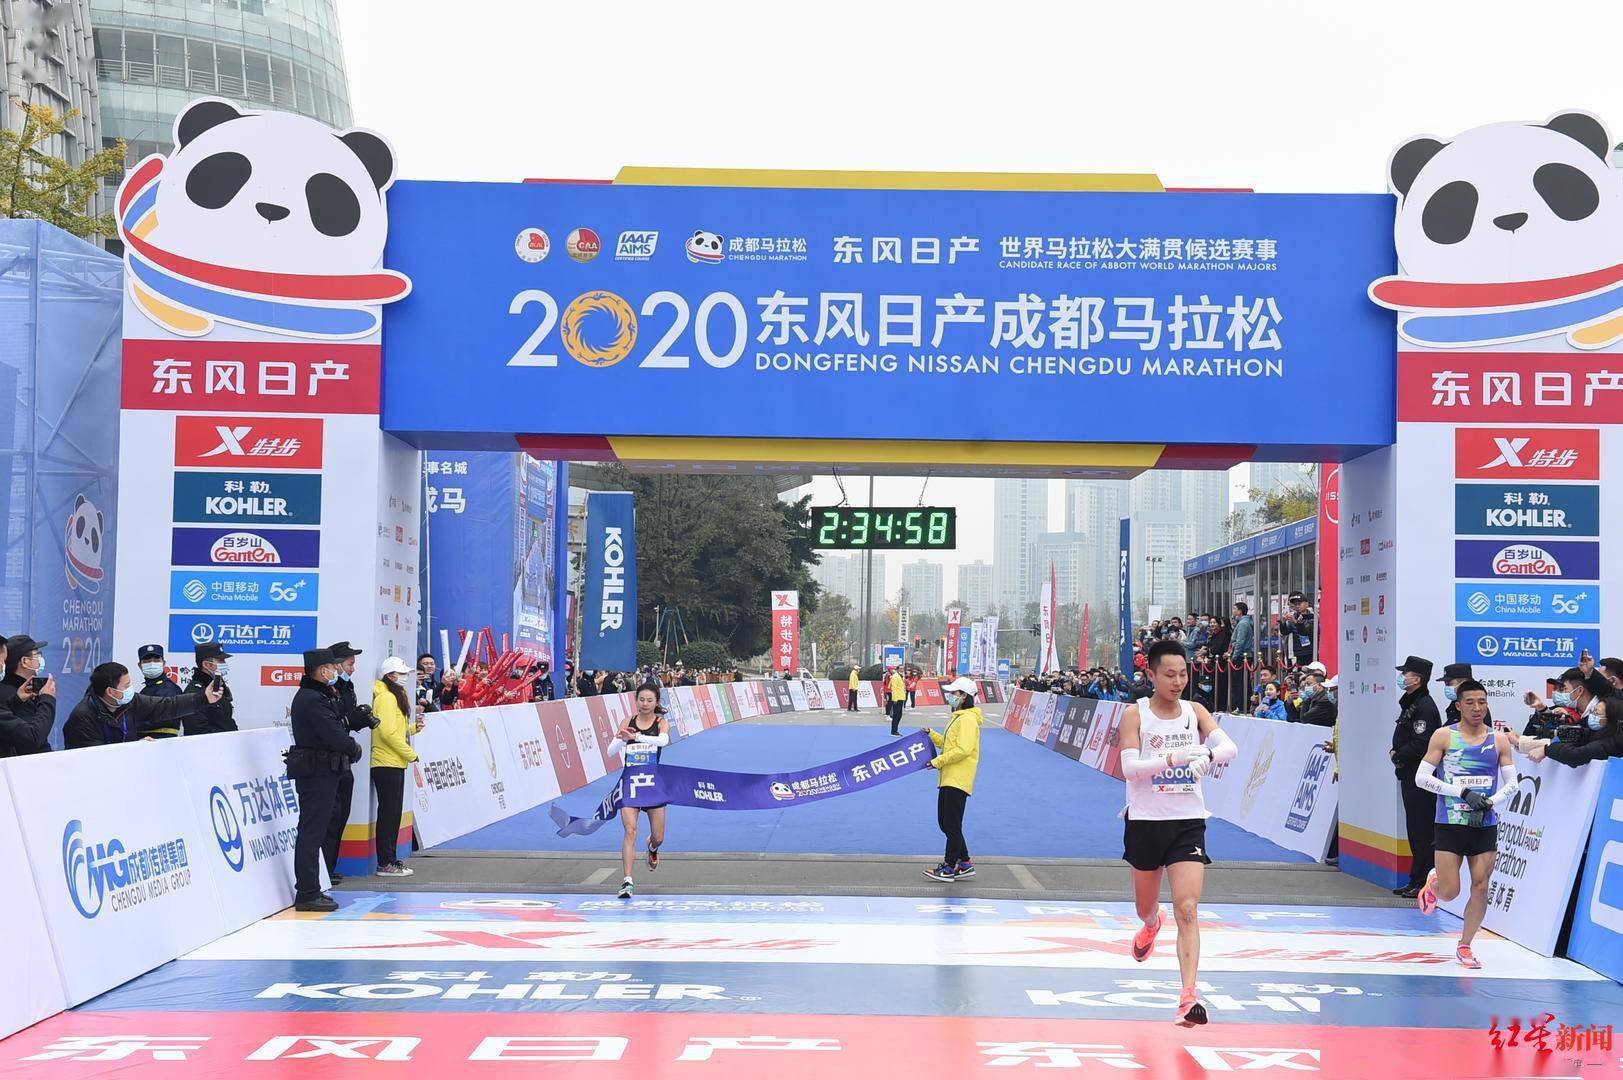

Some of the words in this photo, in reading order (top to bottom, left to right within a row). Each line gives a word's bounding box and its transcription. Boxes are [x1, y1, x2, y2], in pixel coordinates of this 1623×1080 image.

[621, 233, 656, 244] IAAF
[728, 237, 808, 253] 成都马拉松
[619, 244, 651, 254] AIMS
[833, 235, 980, 264] 东风日产
[999, 236, 1278, 261] 世界马拉松大满贯候选赛事
[728, 254, 767, 262] CHENGDU
[999, 260, 1053, 269] CANDIDATE
[1056, 261, 1081, 270] RACE
[1084, 261, 1098, 270] OF
[1101, 262, 1137, 270] ABBOTT
[1140, 262, 1175, 271] WORLD
[1178, 262, 1234, 271] MARATHON
[1237, 263, 1277, 272] MAJORS
[756, 289, 1283, 352] 东风日产成都马拉松
[755, 352, 898, 373] DONGFENG
[908, 354, 999, 374] NISSAN
[1009, 356, 1131, 376] CHENGDU
[1142, 357, 1283, 377] MARATHON
[152, 358, 350, 396] 东风日产
[1431, 369, 1623, 406] 东风日产
[423, 461, 468, 475] 事名城
[224, 481, 269, 494] 科勒
[205, 496, 288, 516] KOHLER
[1504, 492, 1549, 505] 科勒
[1486, 508, 1567, 528] KOHLER
[819, 512, 948, 544] 2:34:58
[223, 537, 262, 548] 百岁山
[1503, 549, 1543, 560] 百岁山
[601, 526, 625, 631] KOHLER
[211, 581, 259, 593] 中国移动
[211, 593, 233, 601] China
[234, 594, 259, 602] Mobile
[1494, 593, 1541, 605] 中国移动
[63, 599, 104, 615] CHENGDU
[1494, 606, 1516, 614] China
[1517, 606, 1542, 614] Mobile
[62, 617, 103, 631] MARATHON
[218, 624, 291, 639] 万达广场
[1502, 637, 1574, 651] 万达广场
[284, 673, 302, 681] 佳得
[851, 742, 926, 783] 东风日产
[1304, 753, 1330, 782] IAAF
[791, 772, 838, 791] 成都马拉松
[233, 773, 299, 827] 万达体育
[694, 789, 725, 802] KOHLER
[1294, 782, 1318, 812] AIMS
[249, 834, 280, 861] WANDA
[278, 826, 298, 853] SPOR
[128, 838, 189, 885] 成都传媒集团
[1495, 848, 1527, 879] arathon
[111, 884, 147, 912] CHENGDU
[148, 876, 170, 899] MEDIA
[170, 868, 191, 890] GROUP
[914, 904, 1332, 920] 东风产
[385, 970, 633, 982] 科勒
[253, 982, 734, 1000] KOHLER
[19, 1034, 844, 1064] 东风日产
